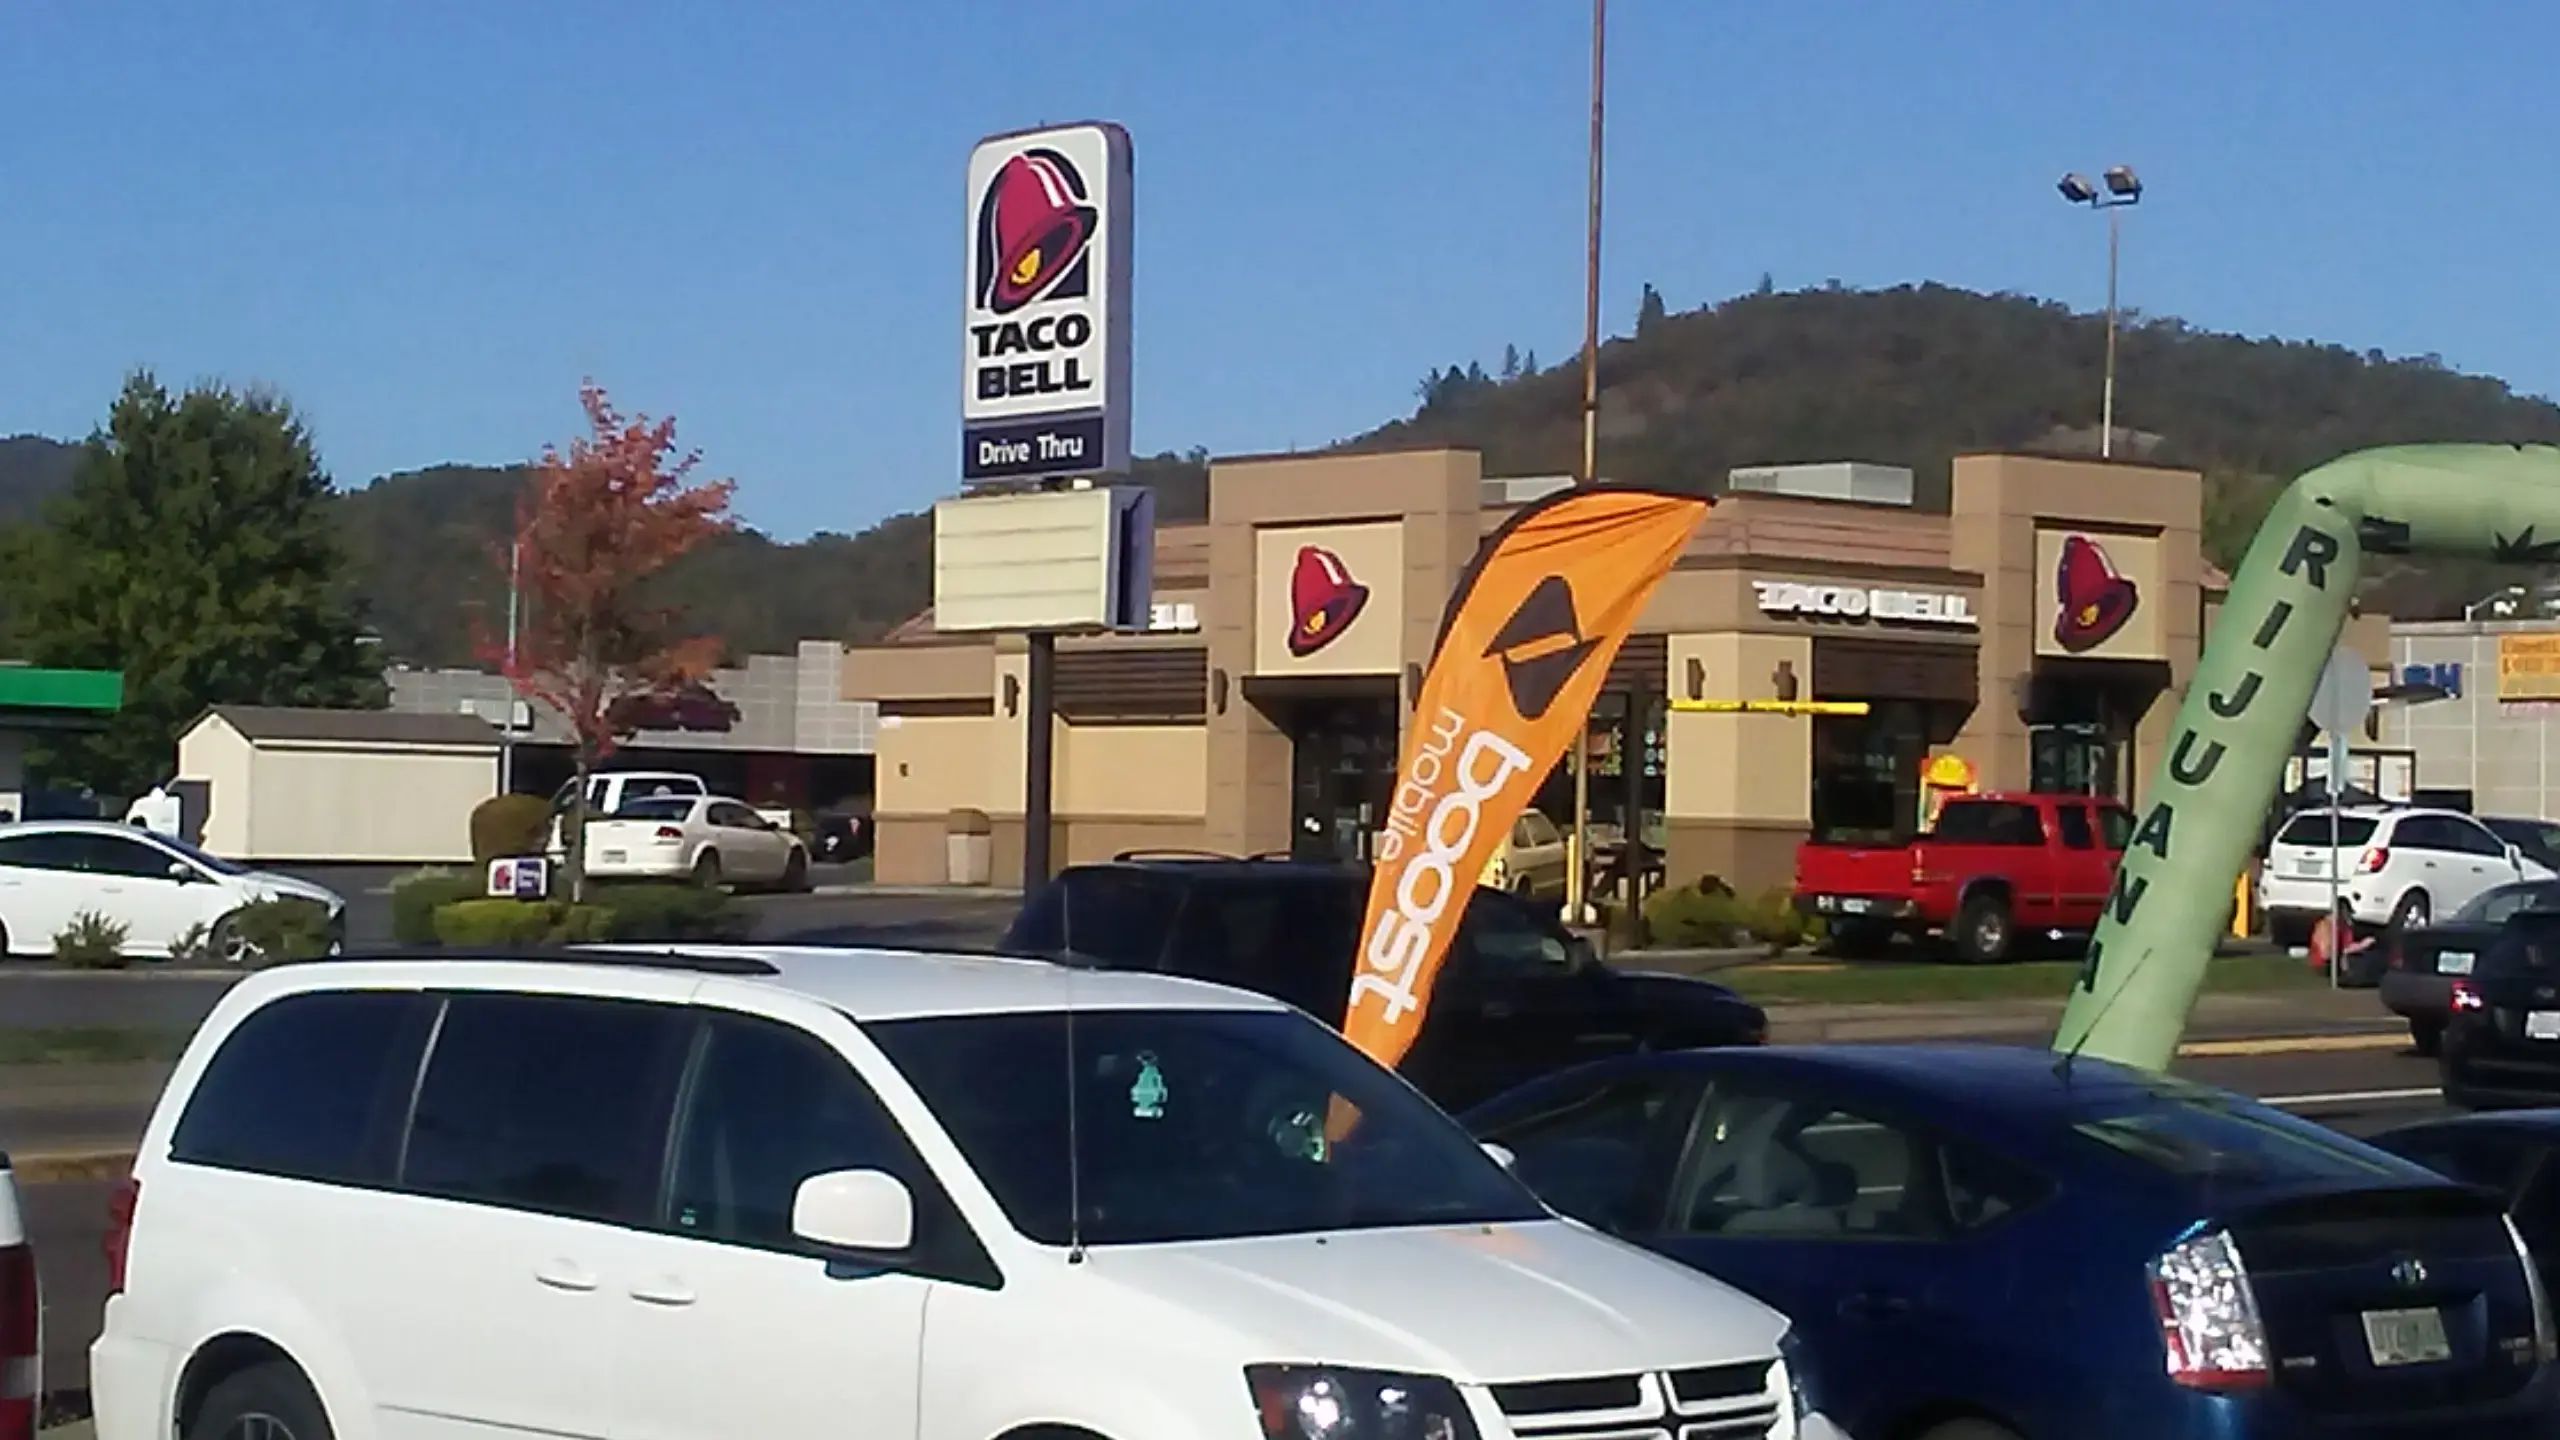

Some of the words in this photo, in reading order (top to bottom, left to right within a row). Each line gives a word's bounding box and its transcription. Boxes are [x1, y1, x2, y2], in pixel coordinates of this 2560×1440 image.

[970, 313, 1091, 358] TACO
[977, 357, 1092, 400] BELL
[978, 438, 1031, 466] Drive
[1036, 431, 1084, 460] Thru
[1752, 580, 1868, 616] TACO
[1869, 588, 1978, 624] BELL
[1380, 705, 1467, 862] mobile
[1350, 730, 1534, 1026] boost
